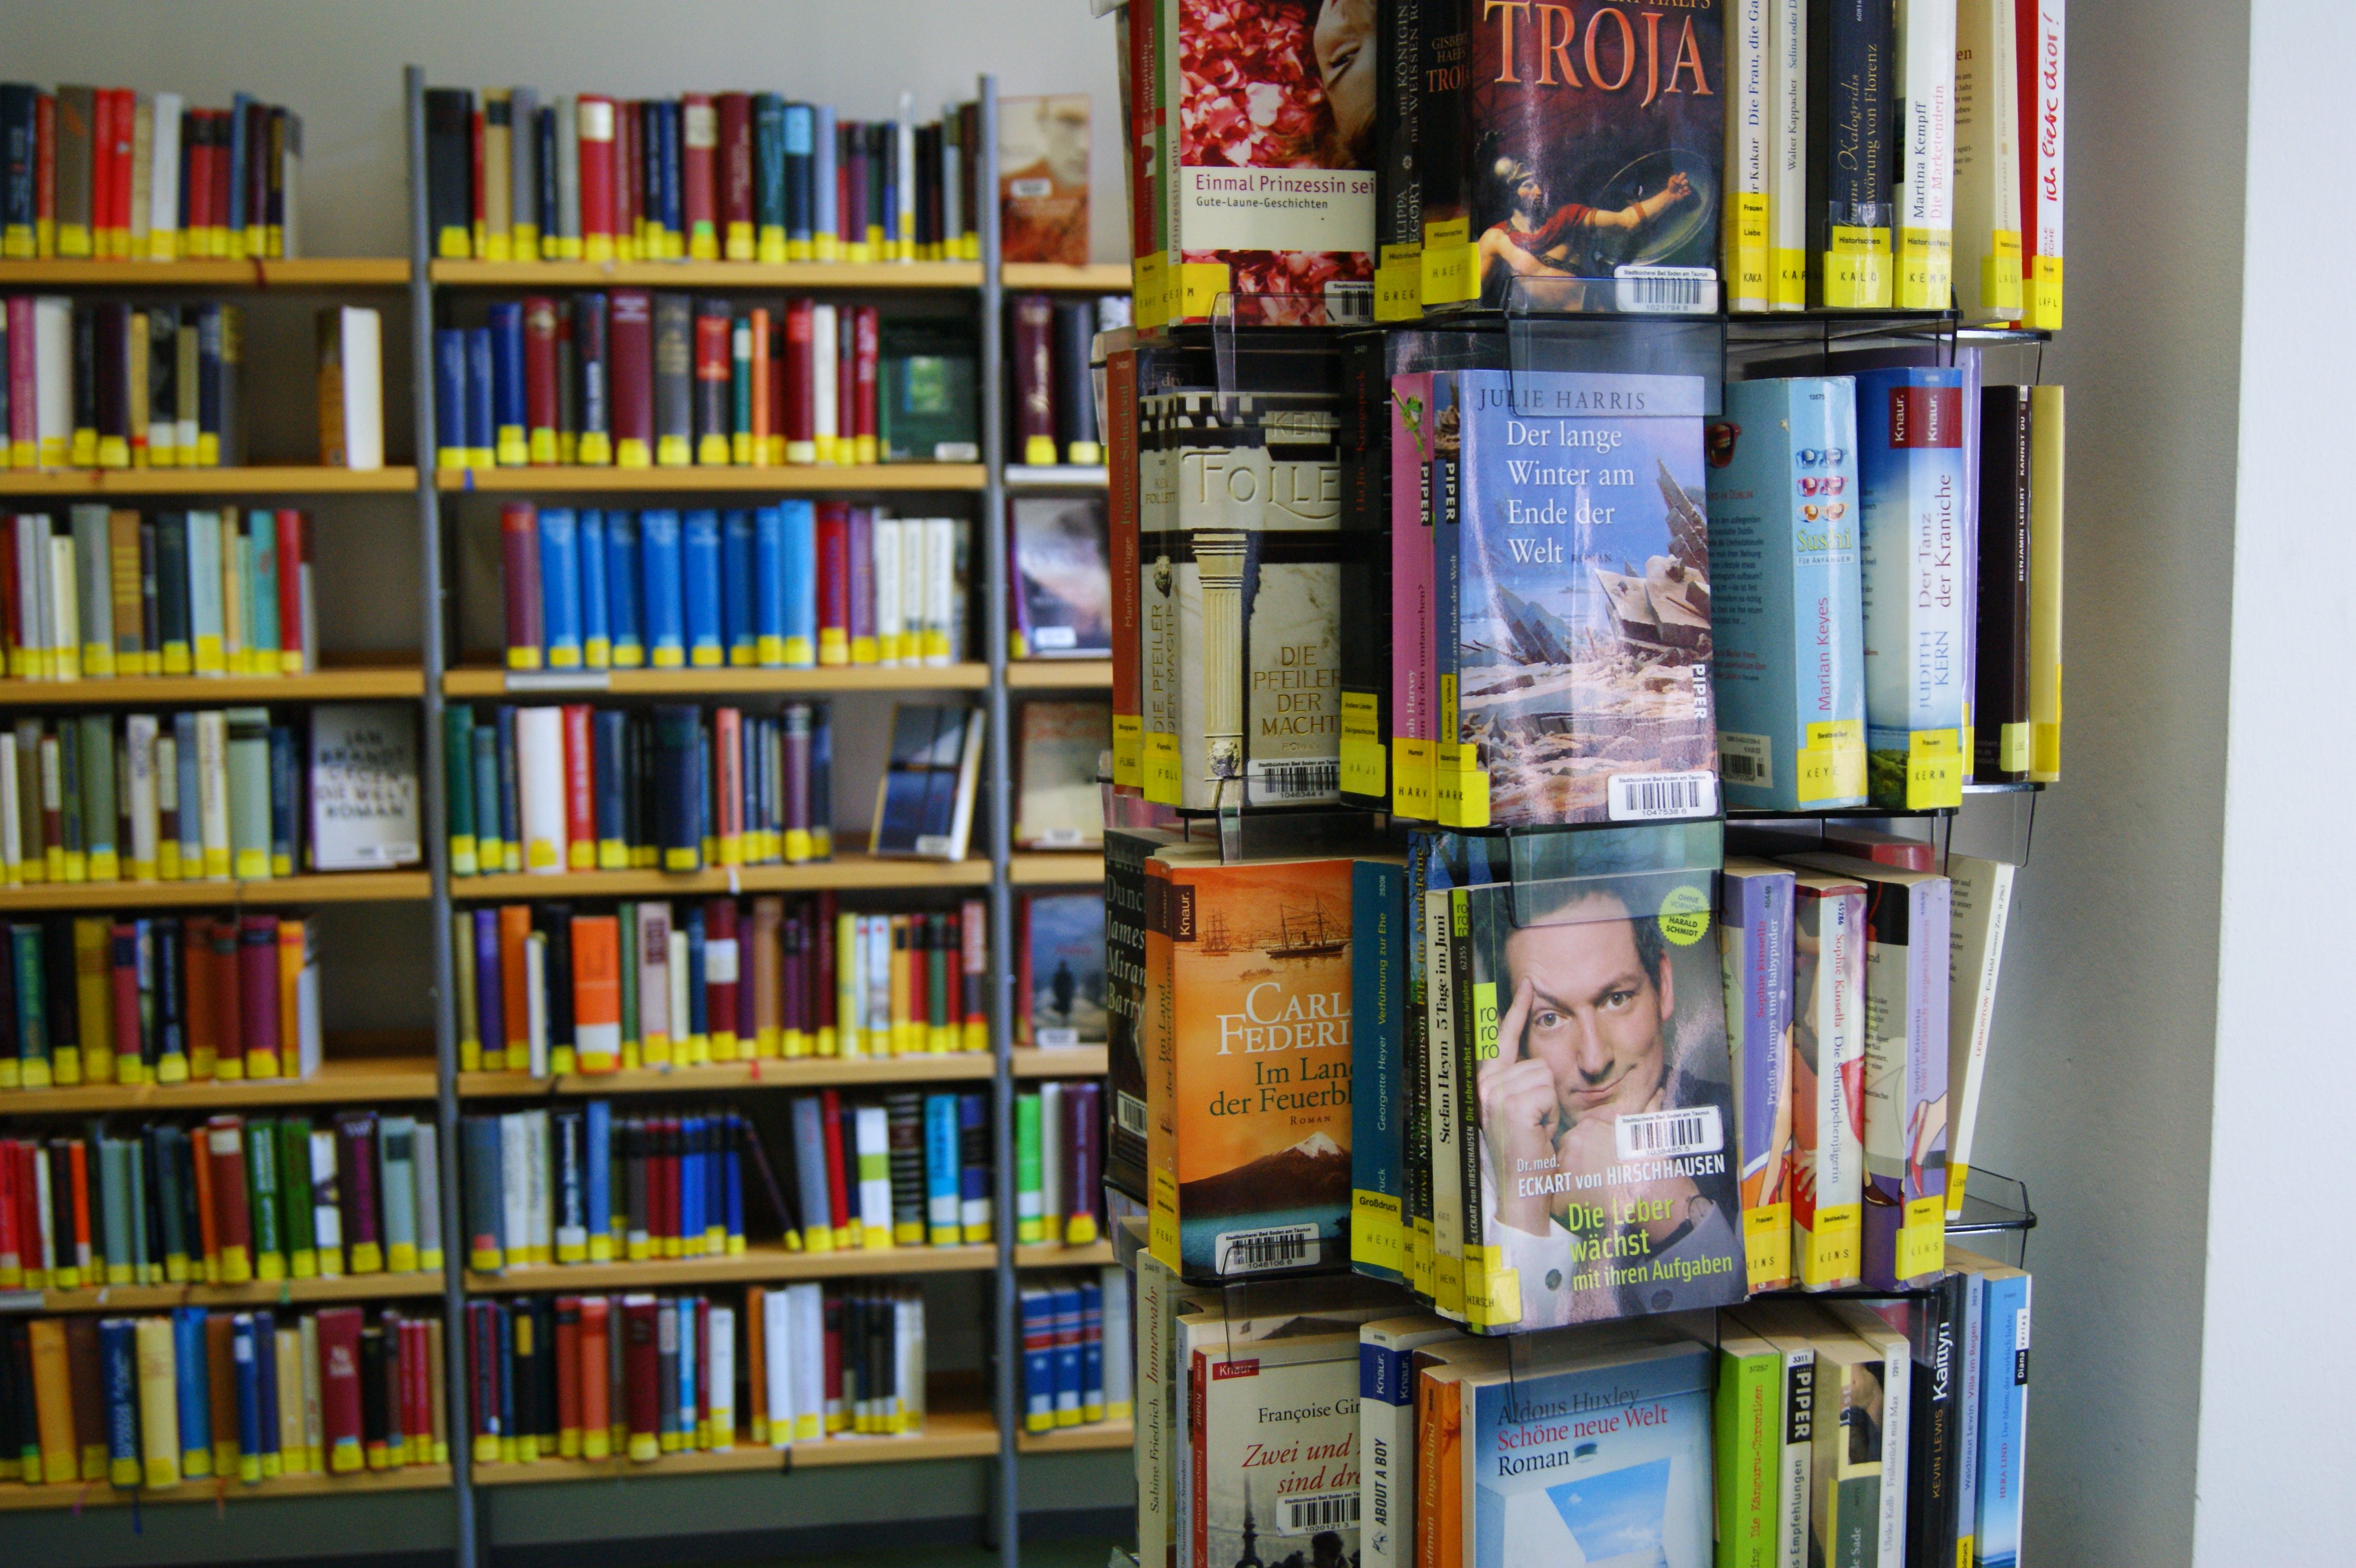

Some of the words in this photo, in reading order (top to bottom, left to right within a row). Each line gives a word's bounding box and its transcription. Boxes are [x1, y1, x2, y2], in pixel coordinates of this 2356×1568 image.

[1748, 26, 1759, 49] die
[1789, 11, 1797, 35] oder
[1396, 5, 1408, 87] KÖNIGIN
[1483, 0, 1713, 109] TROJA
[1748, 54, 1760, 94] Frau,
[1865, 44, 1878, 102] Florenz
[1748, 99, 1759, 126] Die
[1788, 79, 1799, 133] Kappacher
[1868, 108, 1878, 135] von
[1914, 101, 1929, 155] Kempff
[1932, 85, 1945, 189] Marketenderin
[2041, 96, 2058, 158] liebe
[1749, 138, 1759, 180] Kakar
[1788, 137, 1797, 171] Walter
[1196, 174, 1253, 191] Einmal
[1260, 175, 1346, 193] Prinzessin
[1913, 162, 1925, 219] Martina
[1196, 197, 1328, 209] Gute-Laune-Geschichten
[1930, 196, 1942, 219] Die
[1743, 272, 1762, 283] KAKA
[1909, 272, 1947, 284] KEMP
[1384, 290, 1415, 302] GREG
[1478, 389, 1544, 411] JULIE
[1556, 391, 1645, 410] HARRIS
[1894, 394, 1905, 442] Knaur.
[1928, 395, 1938, 442] Knaur.
[2020, 416, 2025, 430] DU
[1506, 421, 1551, 446] Der
[1560, 421, 1622, 454] lange
[1506, 460, 1591, 486] Winter
[1598, 469, 1635, 486] am
[1420, 465, 1429, 523] PIPER
[1445, 462, 1456, 520] PIPER
[1507, 499, 1569, 525] Ende
[1576, 499, 1616, 525] der
[1935, 474, 1952, 567] Kraniche
[1507, 538, 1563, 564] Welt
[1797, 530, 1852, 553] Sushi
[1918, 513, 1932, 564] Tanz
[1918, 569, 1932, 608] Der
[1936, 575, 1952, 607] der
[1816, 597, 1832, 645] Keyes
[1152, 604, 1164, 691] PFEILER
[1281, 645, 1318, 666] DIE
[1934, 631, 1949, 685] KERN
[1817, 652, 1831, 711] Marian
[1919, 632, 1933, 709] JUDITH
[1277, 693, 1321, 713] DER
[1692, 663, 1708, 719] PIPER
[1153, 700, 1165, 734] DIE
[1262, 715, 1338, 737] MACHT
[1398, 787, 1428, 798] HARV
[1107, 910, 1145, 949] James
[1180, 891, 1190, 936] Knaur.
[1378, 913, 1387, 934] Ehe
[1666, 925, 1698, 937] SCHMIDT
[1668, 916, 1698, 928] HARALD
[1379, 937, 1387, 956] zur
[1435, 915, 1447, 950] Juni
[1755, 920, 1766, 971] Kinsella
[1435, 953, 1447, 974] im
[1768, 918, 1780, 986] Babypuder
[1833, 933, 1845, 975] Sophie
[1245, 982, 1352, 1025] CARL
[1378, 959, 1389, 1025] Verführung
[1436, 978, 1448, 1016] Tage
[1755, 973, 1766, 1017] Sophie
[1767, 991, 1777, 1015] und
[1833, 980, 1844, 1027] Kinsella
[1437, 1019, 1448, 1030] 5
[1480, 1007, 1498, 1022] ro
[1976, 995, 1989, 1056] LERMONTOW
[1480, 1026, 1499, 1041] ro
[1767, 1019, 1778, 1062] Pumps
[1833, 1036, 1843, 1057] Die
[1377, 1035, 1388, 1070] Heyer
[1417, 1016, 1427, 1108] Hermanson
[1464, 1047, 1474, 1080] wächst
[1481, 1044, 1499, 1059] ro
[1254, 1060, 1289, 1086] Im
[1766, 1065, 1778, 1105] Prada,
[1209, 1090, 1252, 1117] der
[1377, 1073, 1388, 1130] Georgette
[1464, 1082, 1475, 1104] Leber
[1439, 1092, 1451, 1144] Stefan
[1465, 1106, 1475, 1122] Die
[1830, 1062, 1843, 1183] Schnäppchenjägerin
[1418, 1115, 1428, 1160] Marie
[1466, 1126, 1477, 1188] HIRSCHHAUSEN
[1517, 1157, 1532, 1173] Dr.
[1533, 1155, 1559, 1170] med.
[1518, 1173, 1572, 1198] ECKART
[1575, 1172, 1602, 1190] von
[1607, 1153, 1725, 1186] HIRSCHHAUSEN
[1359, 1196, 1398, 1213] Großdruck
[1468, 1204, 1478, 1233] ECKART
[1568, 1203, 1605, 1232] Die
[1613, 1197, 1674, 1226] Leber
[1367, 1232, 1398, 1249] HEYE
[1569, 1229, 1651, 1263] wächst
[1820, 1249, 1849, 1263] KINS
[1573, 1270, 1600, 1291] mit
[1605, 1264, 1647, 1285] ihren
[1653, 1255, 1732, 1284] Aufgaben
[1466, 1295, 1494, 1308] HIRSCH
[1145, 1285, 1160, 1386] Immerwahr
[1219, 1363, 1252, 1377] Knaur
[1376, 1353, 1385, 1395] Knaur.
[1792, 1355, 1808, 1363] 3311
[2017, 1351, 2025, 1378] Diana
[1400, 1356, 1409, 1399] Knaur.
[1258, 1405, 1331, 1424] Françoise
[1497, 1399, 1566, 1427] Aldous
[1573, 1386, 1640, 1415] Huxley
[1795, 1371, 1812, 1438] PIPER
[1149, 1398, 1159, 1461] Friedrich
[1497, 1423, 1568, 1452] Schöne
[1573, 1415, 1620, 1438] neue
[1623, 1404, 1668, 1429] Welt
[1933, 1409, 1943, 1453] LEWIS
[1242, 1440, 1300, 1469] Zwei
[1306, 1432, 1352, 1460] und
[1375, 1438, 1387, 1466] BOY
[1425, 1422, 1436, 1507] Engelskind
[1497, 1448, 1570, 1477] Roman
[2000, 1442, 2008, 1468] LIND
[1150, 1464, 1160, 1514] Sabine
[1277, 1470, 1325, 1494] sind
[1375, 1470, 1387, 1479] A
[1932, 1457, 1942, 1498] KEVIN
[1375, 1480, 1387, 1526] ABOUT
[1790, 1459, 1804, 1554] Empfehlungen
[1750, 1518, 1761, 1538] Die
